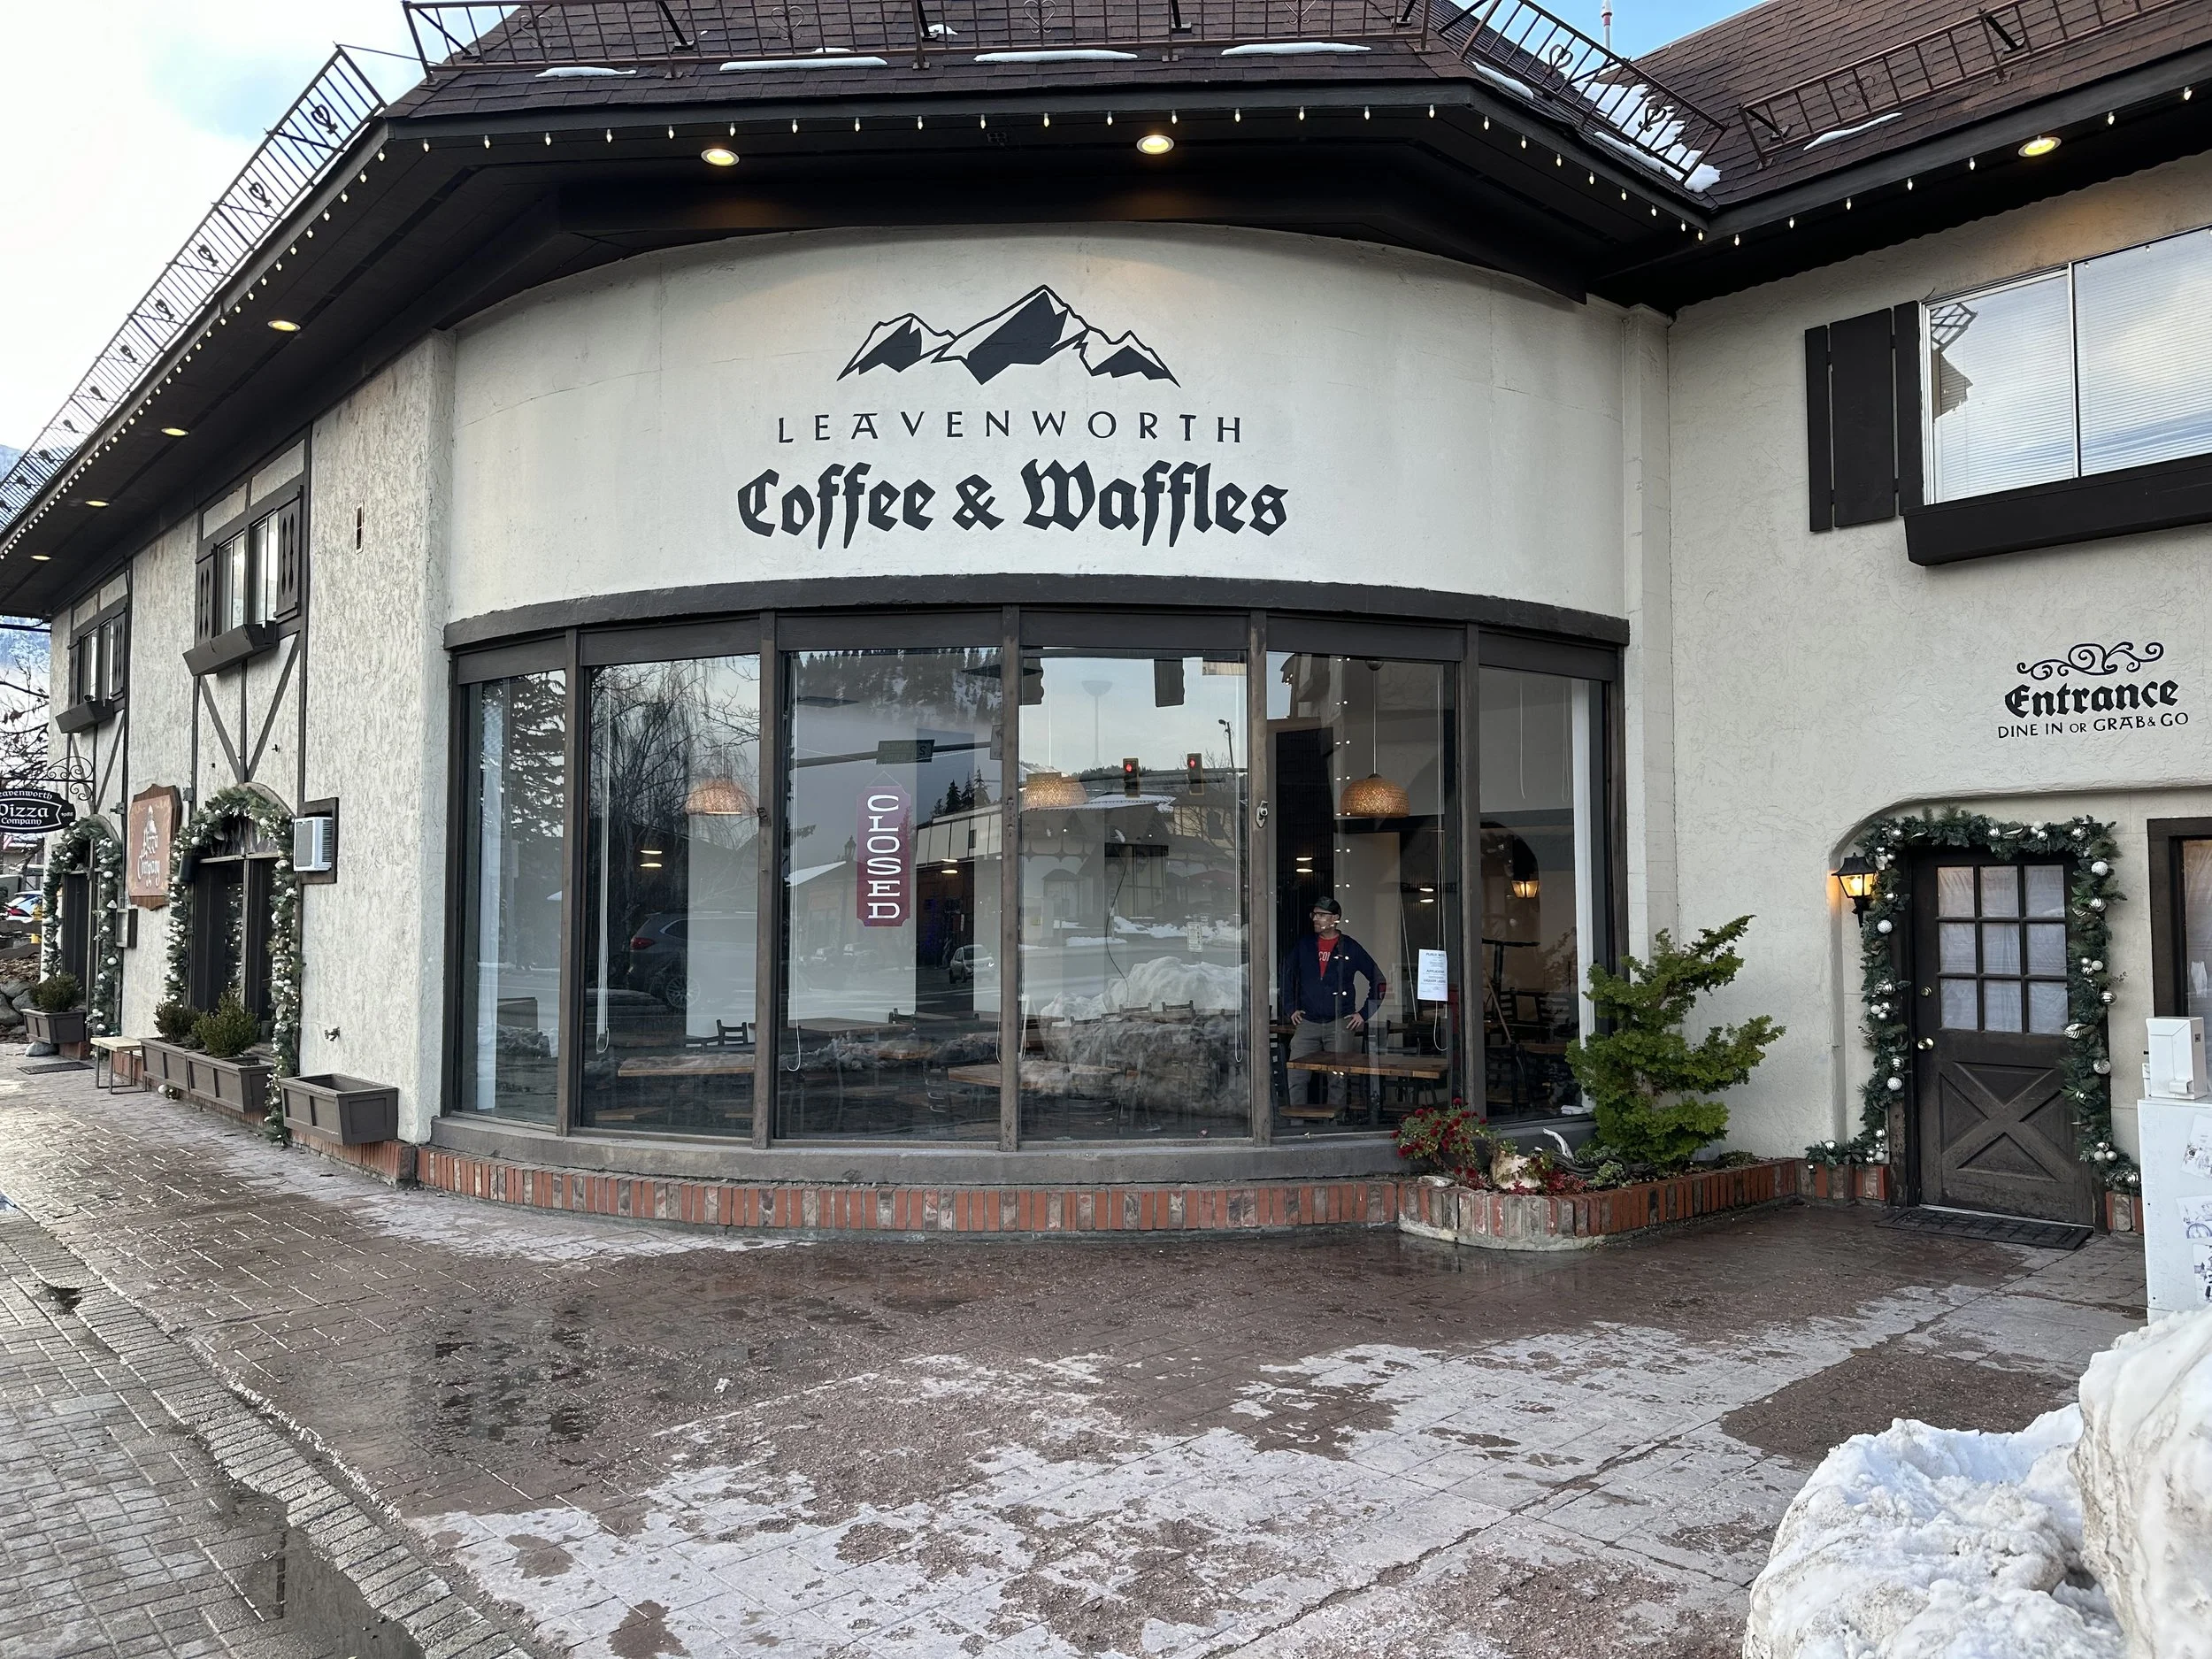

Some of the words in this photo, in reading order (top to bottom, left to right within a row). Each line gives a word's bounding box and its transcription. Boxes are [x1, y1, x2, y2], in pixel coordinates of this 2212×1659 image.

[779, 410, 1240, 443] LEAVENWORTH
[737, 462, 936, 550] Coffee
[951, 473, 1005, 531] &
[1020, 458, 1289, 548] Waffles
[2004, 680, 2179, 718] Entrance
[1997, 723, 2039, 739] DINE
[2045, 721, 2063, 735] IN
[2069, 722, 2087, 733] OR
[2160, 711, 2189, 727] GO
[1, 817, 42, 826] Company
[866, 795, 902, 919] CLOSED
